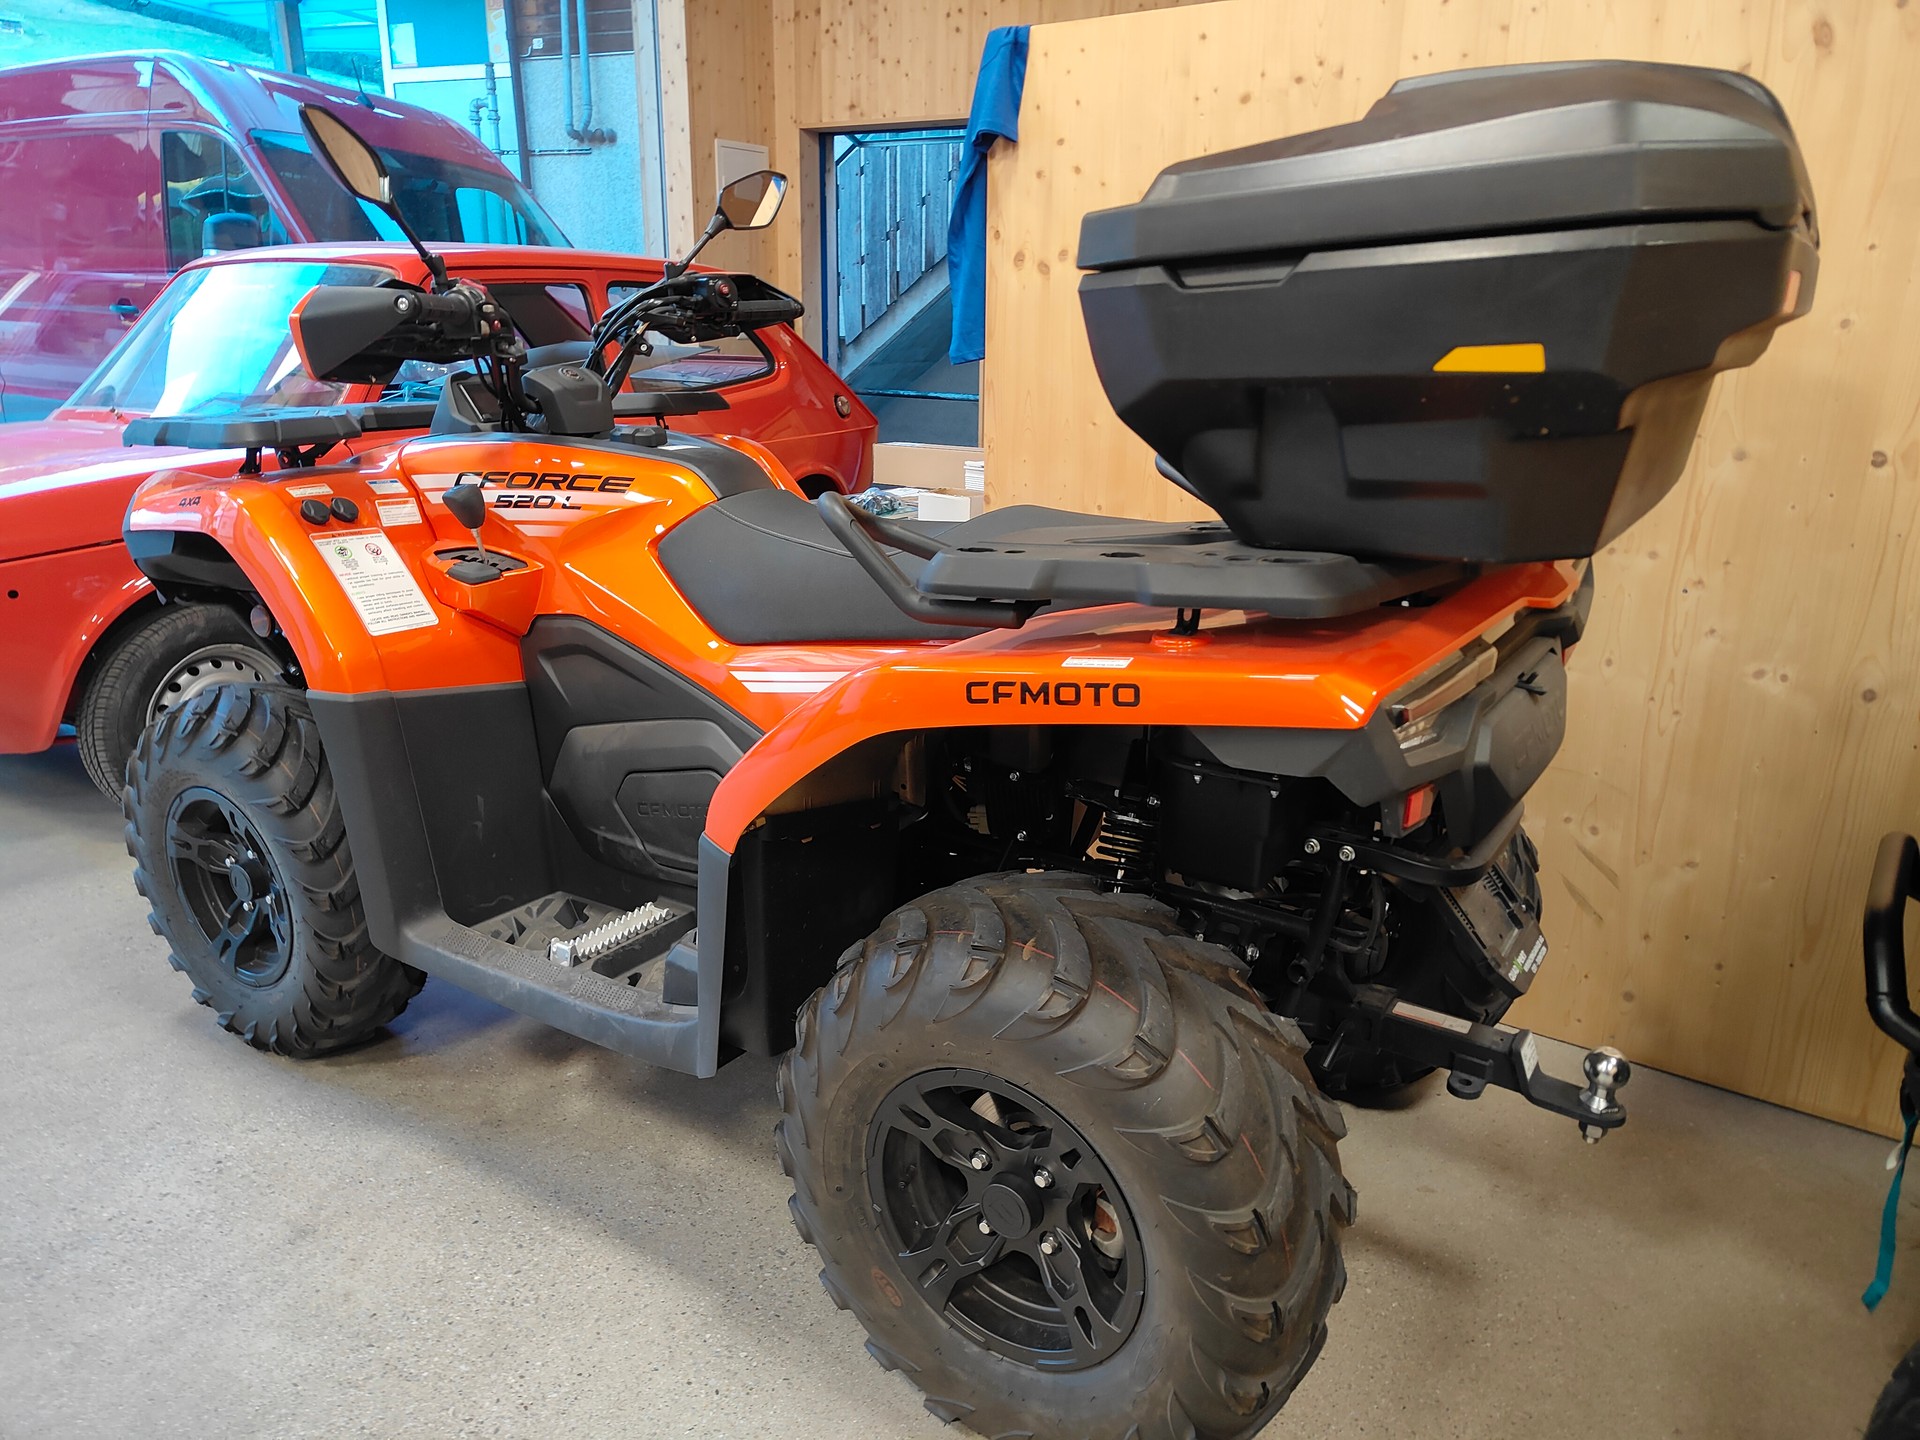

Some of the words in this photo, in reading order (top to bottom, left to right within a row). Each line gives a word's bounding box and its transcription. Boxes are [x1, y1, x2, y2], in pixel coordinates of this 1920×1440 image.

[454, 471, 635, 493] CFORCE
[494, 494, 556, 509] 520
[965, 681, 1140, 707] CFMOTO
[637, 802, 709, 819] CFMOT
